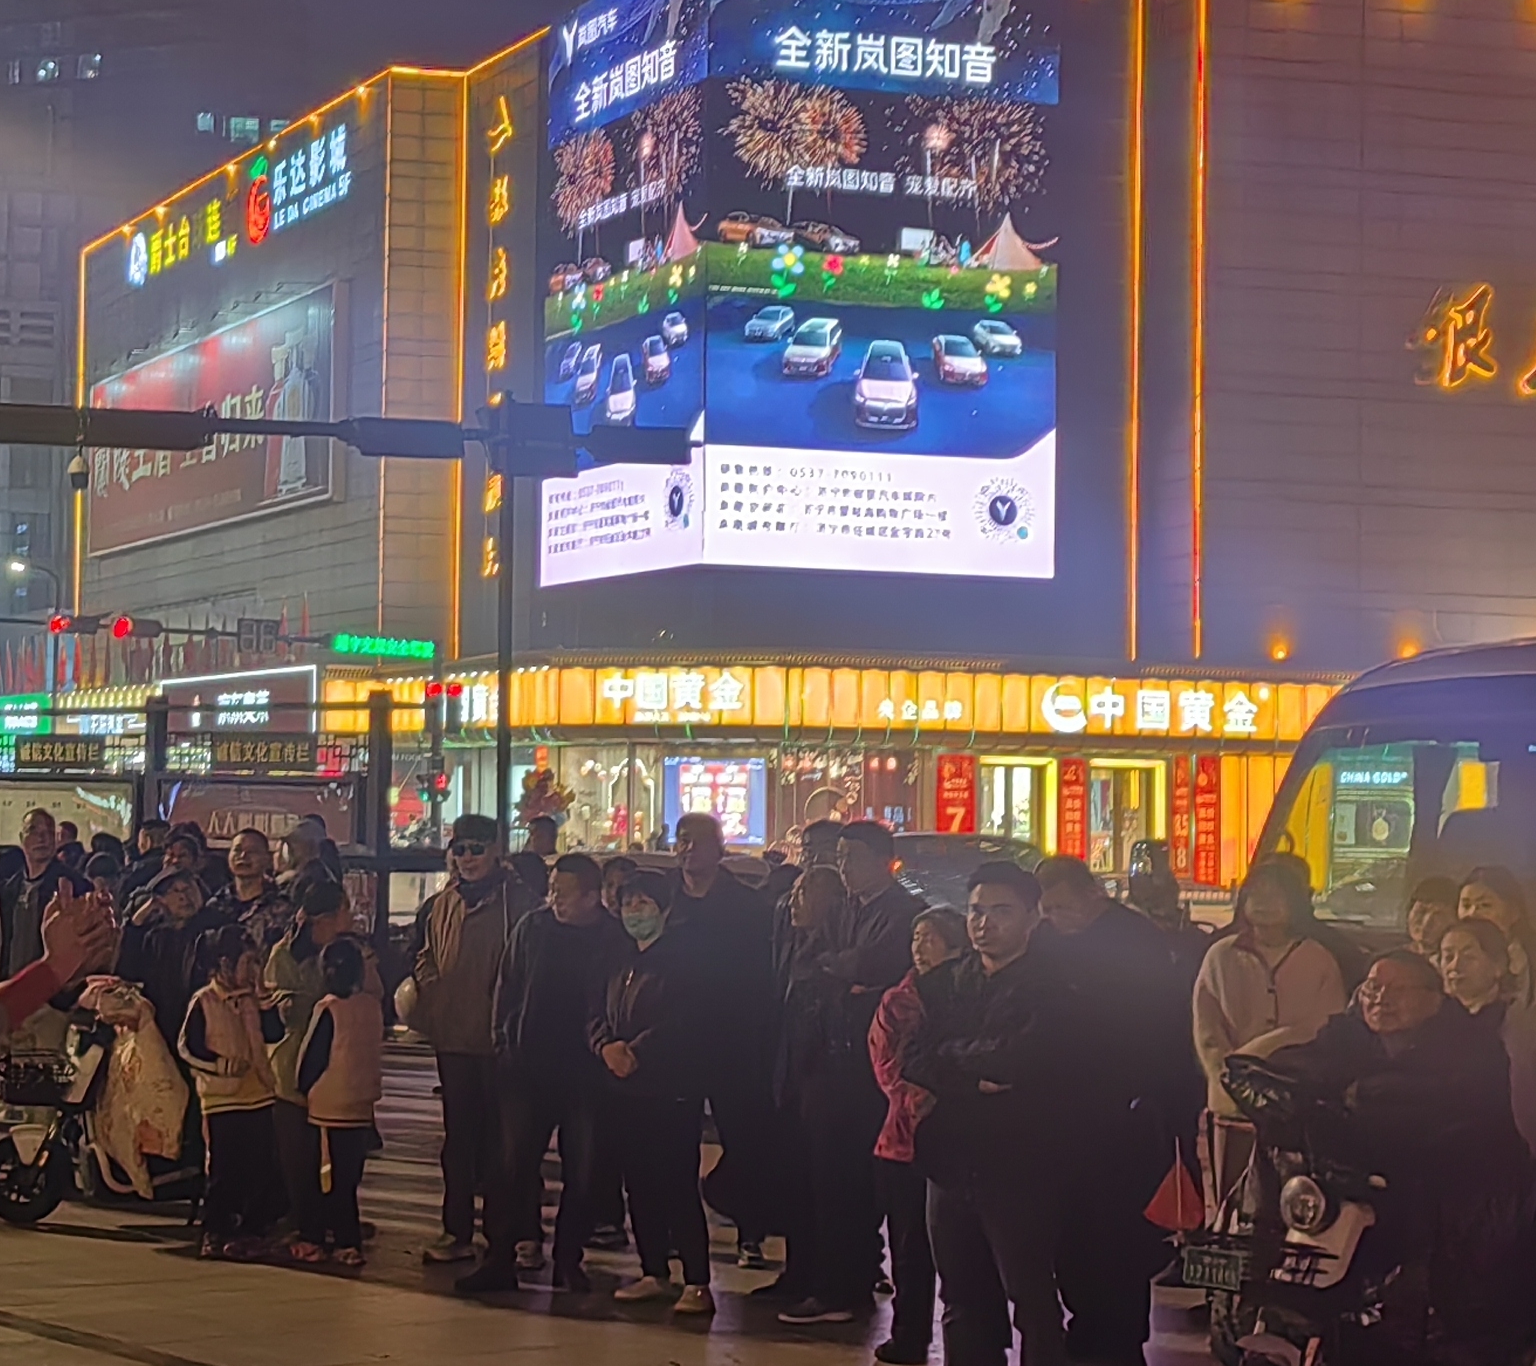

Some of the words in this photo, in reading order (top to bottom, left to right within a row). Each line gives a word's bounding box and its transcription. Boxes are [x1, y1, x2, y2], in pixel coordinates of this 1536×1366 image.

[774, 25, 997, 83] 全新岚图知音
[574, 38, 677, 122] 全新岚图知音
[785, 163, 897, 195] 全新岚图知音
[602, 670, 745, 711] 中国黄金
[1089, 685, 1258, 733] 中国黄金
[216, 740, 311, 763] 诚信文化宣传栏
[1340, 771, 1371, 784] CHINA
